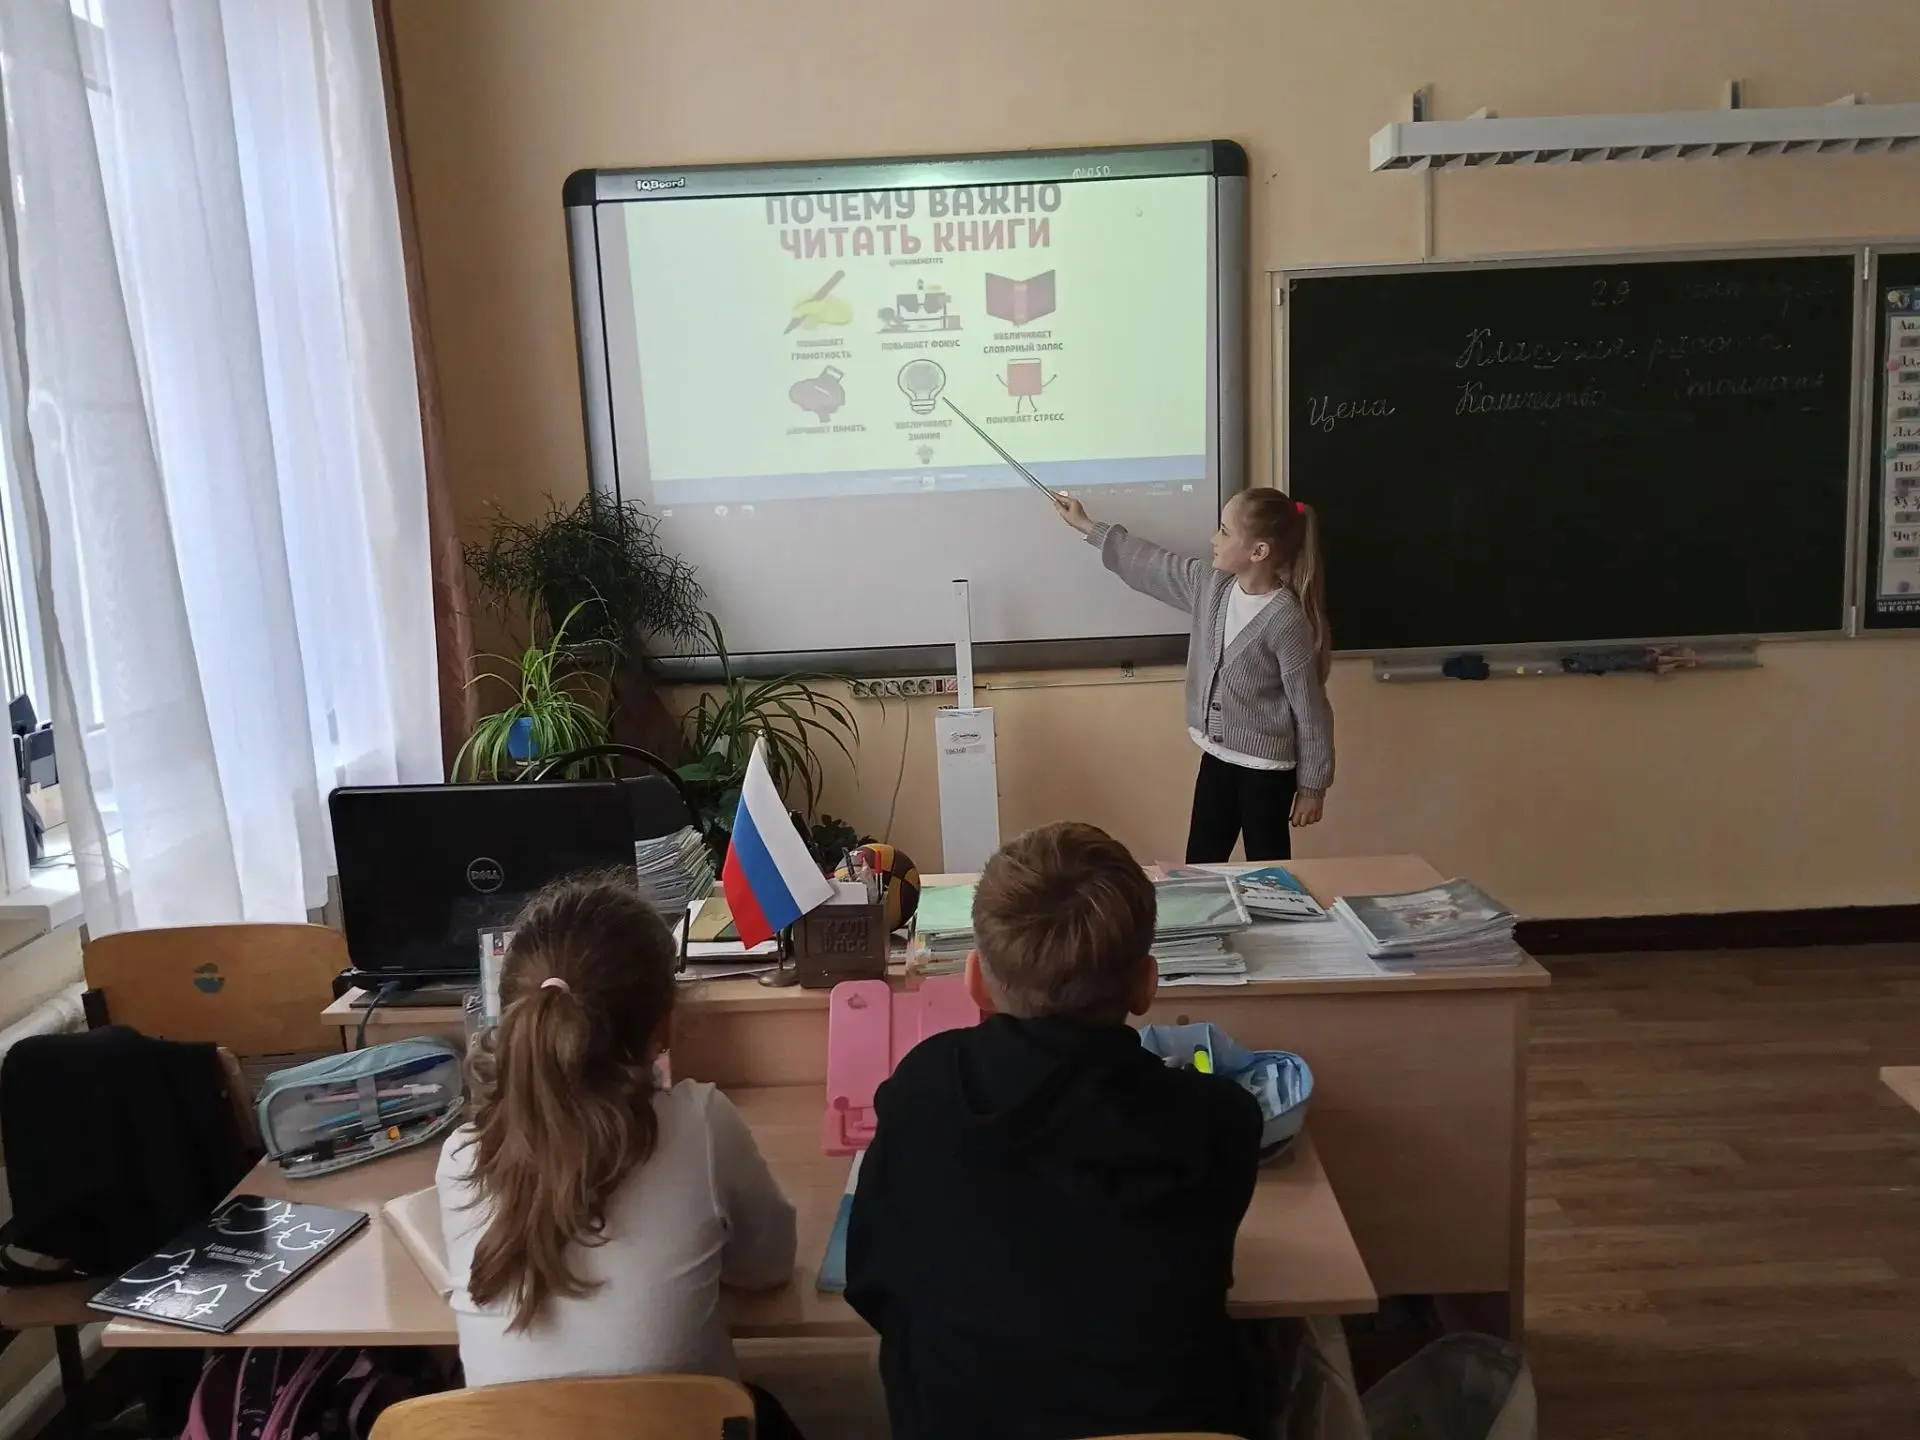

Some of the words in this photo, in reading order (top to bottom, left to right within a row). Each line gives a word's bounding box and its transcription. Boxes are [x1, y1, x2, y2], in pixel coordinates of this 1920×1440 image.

[765, 189, 916, 225] ПОЧЕМУ
[929, 183, 1062, 218] ВАЖНО
[780, 223, 923, 260] ЧИТАТЬ
[933, 217, 1051, 254] КНИГИ
[930, 339, 961, 349] ФОКУС
[983, 343, 1035, 354] СЛОВАРНЫЙ
[1036, 342, 1064, 351] ЗАПАС
[1033, 412, 1065, 422] СТРЕСС
[1307, 394, 1397, 434] Цена
